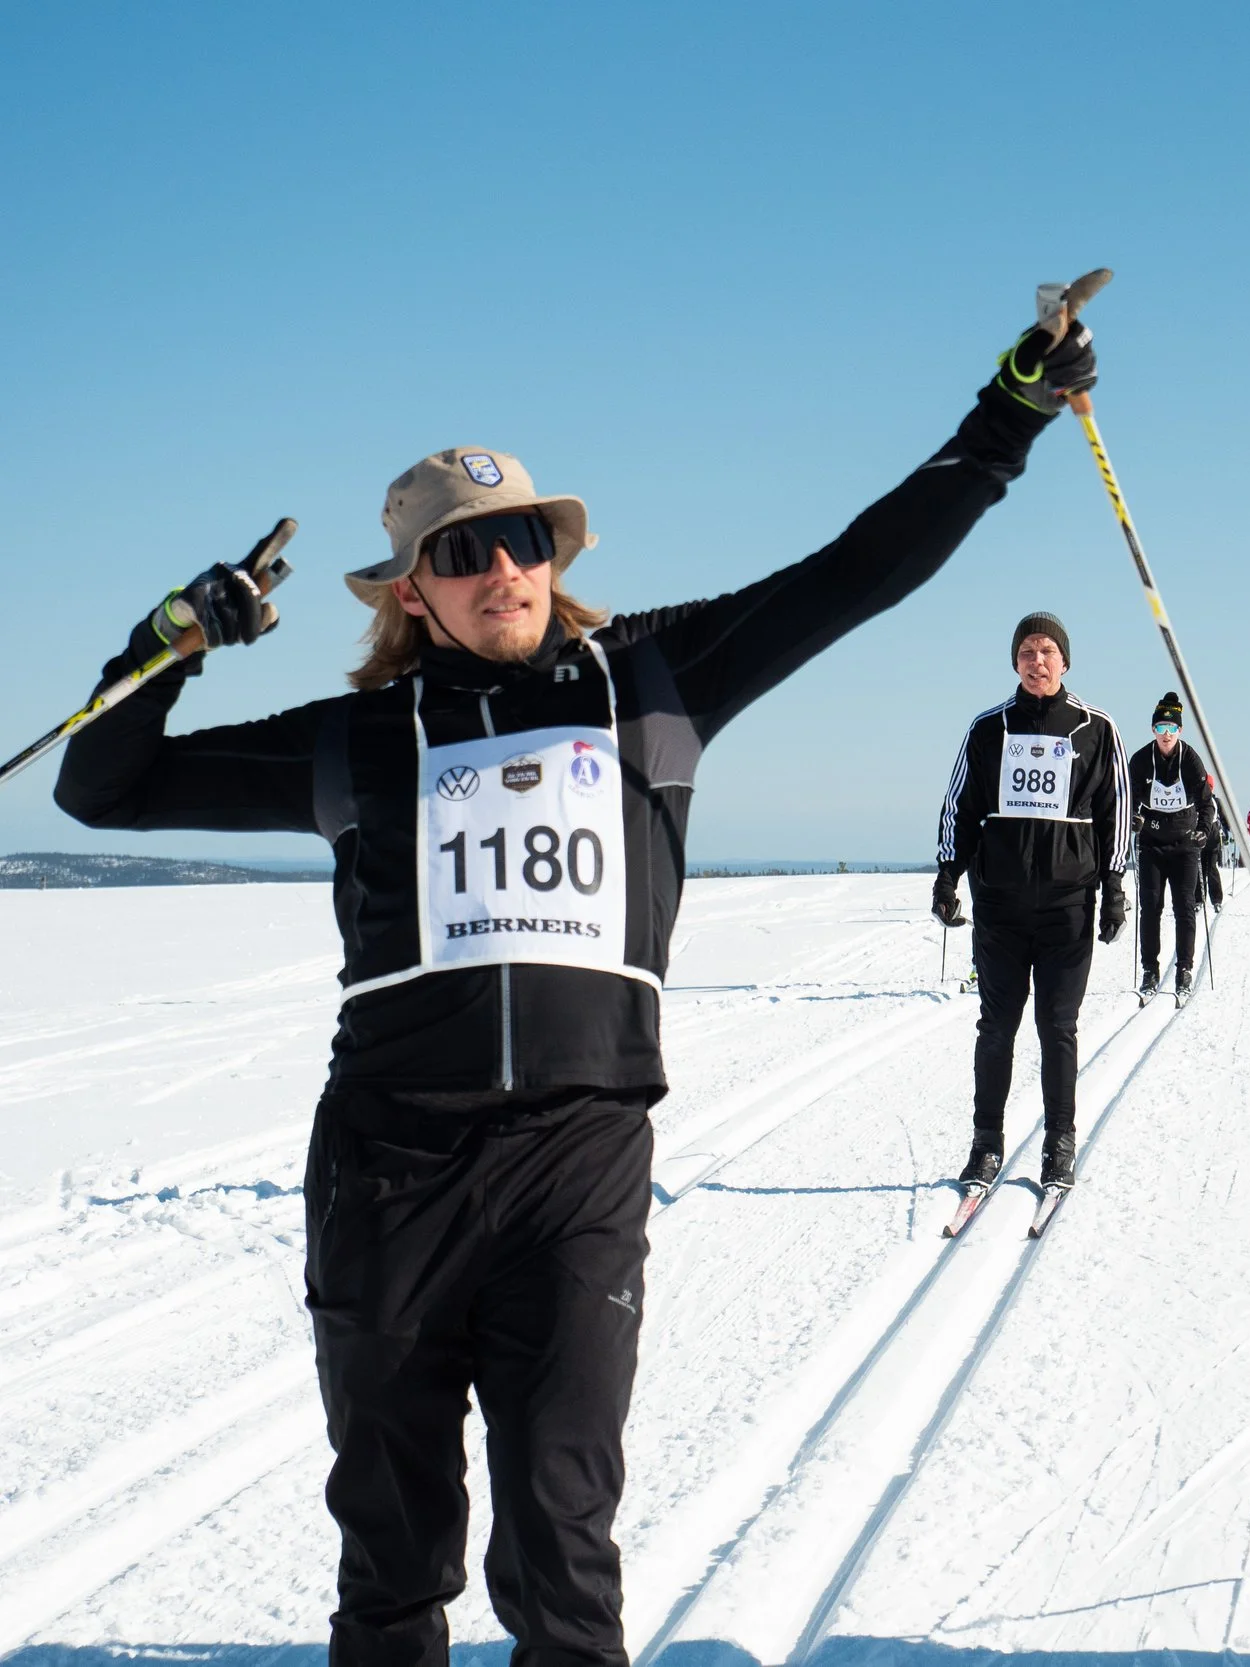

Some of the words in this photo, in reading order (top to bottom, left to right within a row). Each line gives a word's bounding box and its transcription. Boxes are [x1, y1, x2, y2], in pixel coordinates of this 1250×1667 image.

[1012, 767, 1056, 794] 988
[1006, 800, 1059, 809] BERNERS
[1153, 797, 1182, 806] 1071
[1151, 820, 1160, 830] 56
[439, 825, 604, 896] 1180
[446, 917, 602, 940] BERNERS
